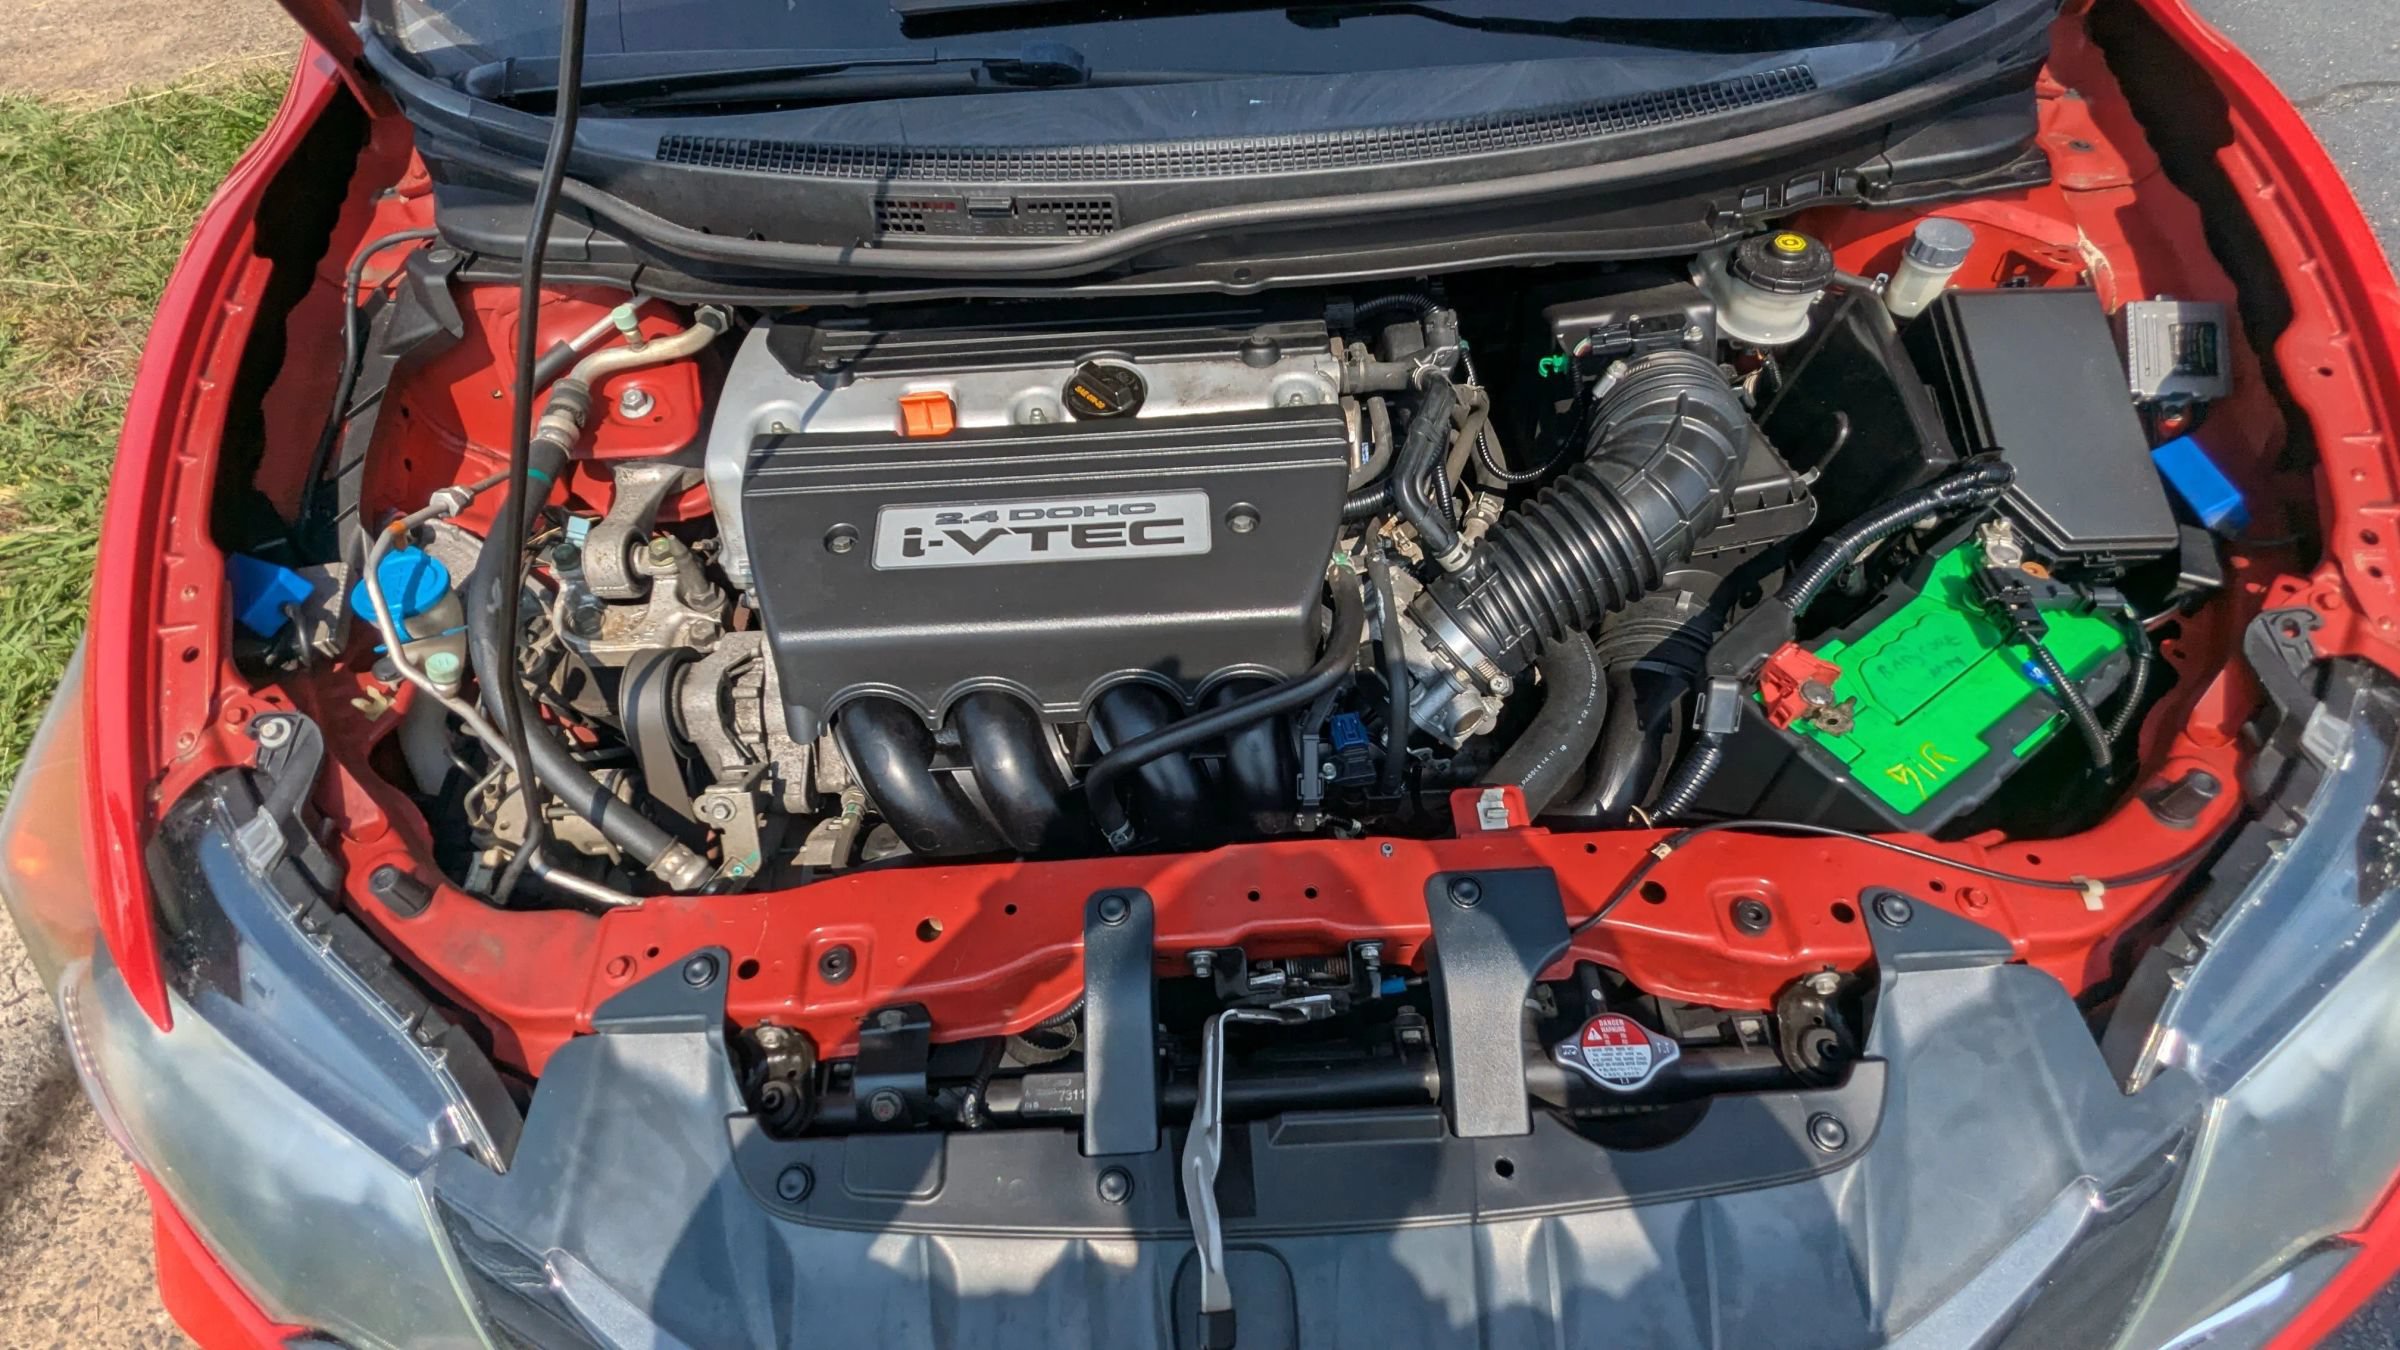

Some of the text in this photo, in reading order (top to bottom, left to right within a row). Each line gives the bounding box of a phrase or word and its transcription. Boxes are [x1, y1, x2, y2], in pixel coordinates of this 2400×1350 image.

[935, 502, 1156, 525] 2.4 DOHC
[902, 518, 1185, 558] i-VTEC
